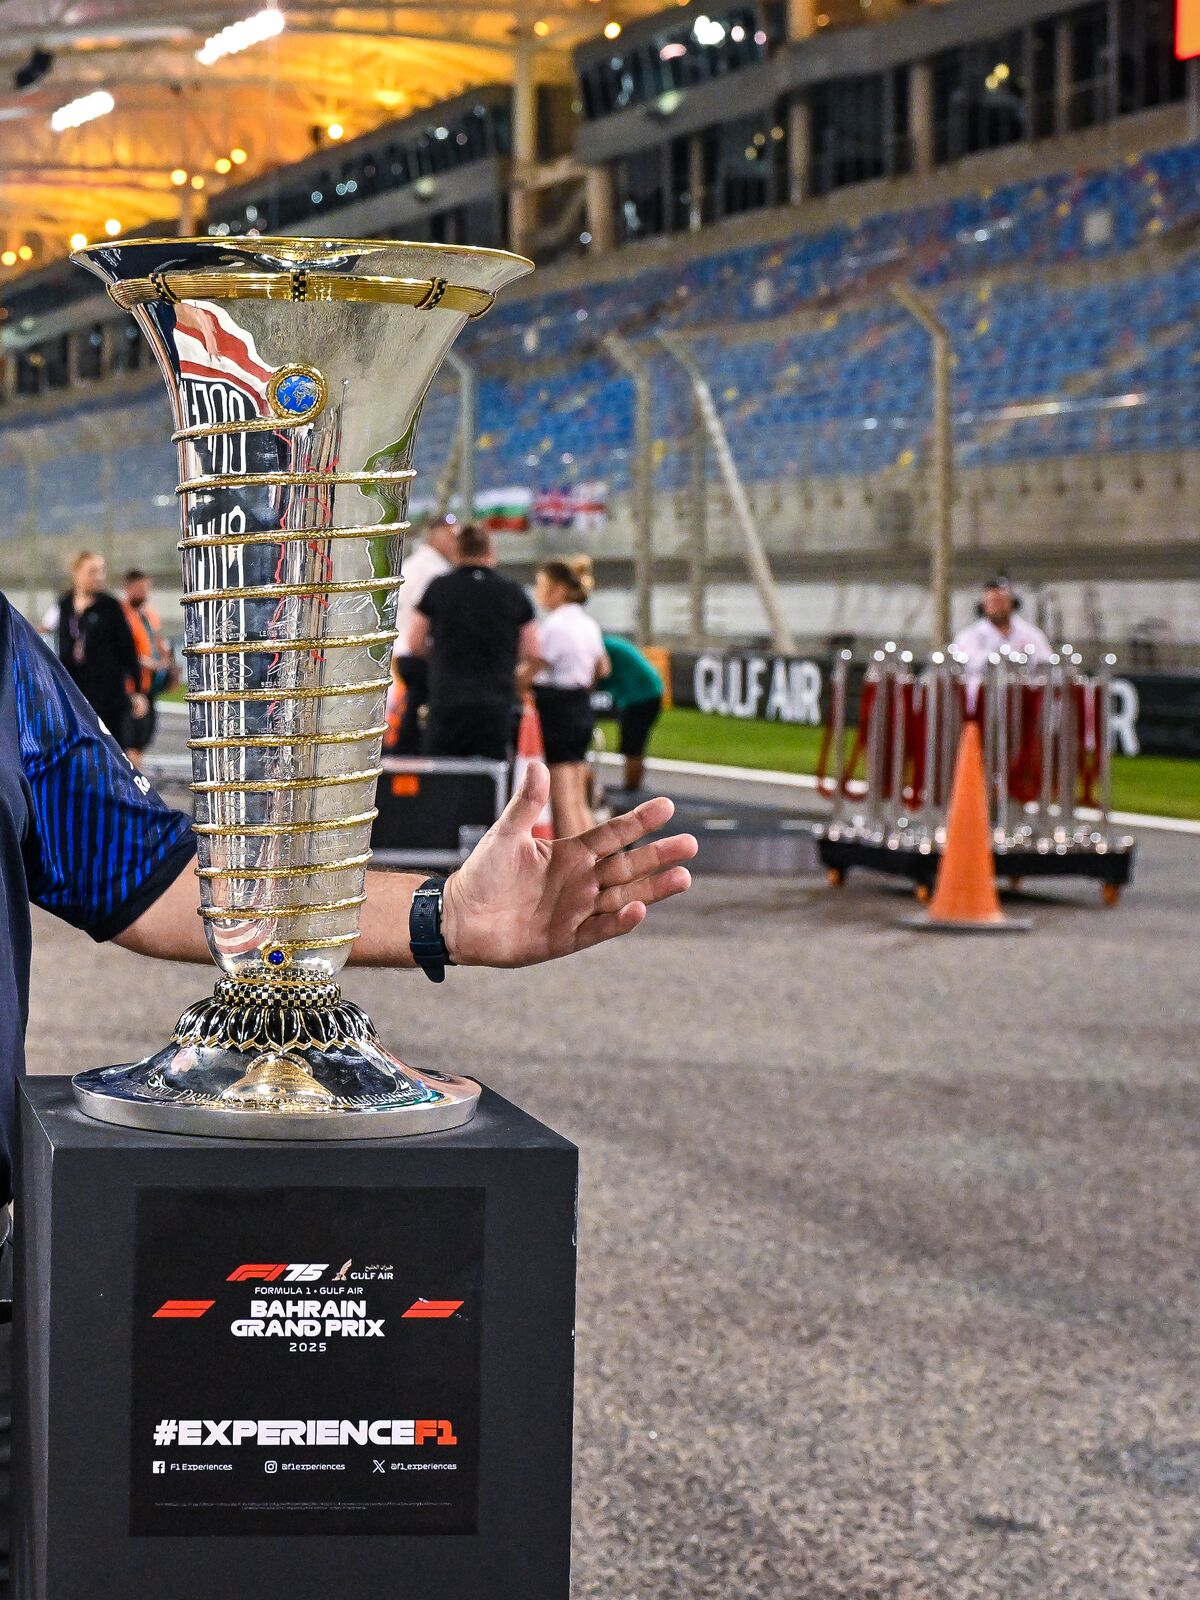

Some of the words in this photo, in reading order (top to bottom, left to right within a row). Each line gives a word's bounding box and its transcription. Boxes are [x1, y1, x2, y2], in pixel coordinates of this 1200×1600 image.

[694, 656, 766, 719] GULF
[765, 659, 822, 725] AIR
[350, 1272, 376, 1280] GULF
[377, 1272, 394, 1280] AIR
[254, 1286, 303, 1295] FORMULA
[305, 1286, 311, 1295] 1
[319, 1286, 345, 1295] GULF
[346, 1286, 364, 1295] AIR
[250, 1300, 367, 1318] BAHRAIN
[230, 1319, 322, 1337] GRAND
[325, 1319, 386, 1337] PRIX
[289, 1342, 327, 1352] 2025
[153, 1419, 458, 1446] #EXPERIENCEF1
[170, 1463, 181, 1471] F1
[182, 1463, 233, 1472] Experiences
[281, 1463, 346, 1471] @f1experiences
[390, 1462, 458, 1471] @f1_experiences
